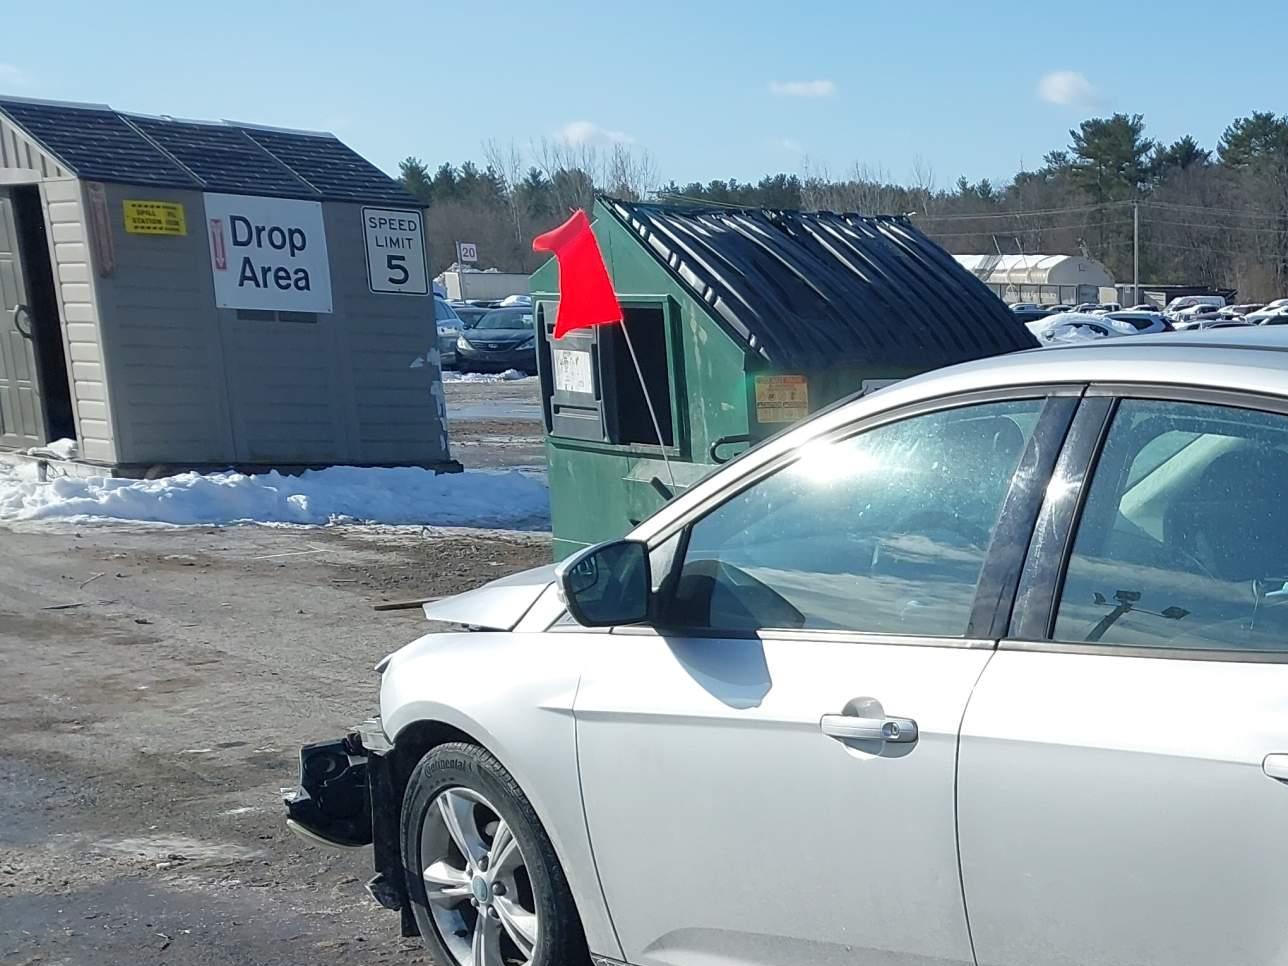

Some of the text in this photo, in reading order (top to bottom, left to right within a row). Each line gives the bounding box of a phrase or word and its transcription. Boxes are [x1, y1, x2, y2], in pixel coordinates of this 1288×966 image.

[368, 216, 417, 232] SPEED
[229, 215, 307, 257] Drop
[375, 235, 414, 250] LIMIT
[462, 247, 475, 258] 20
[238, 256, 310, 291] Area
[387, 255, 409, 285] 5
